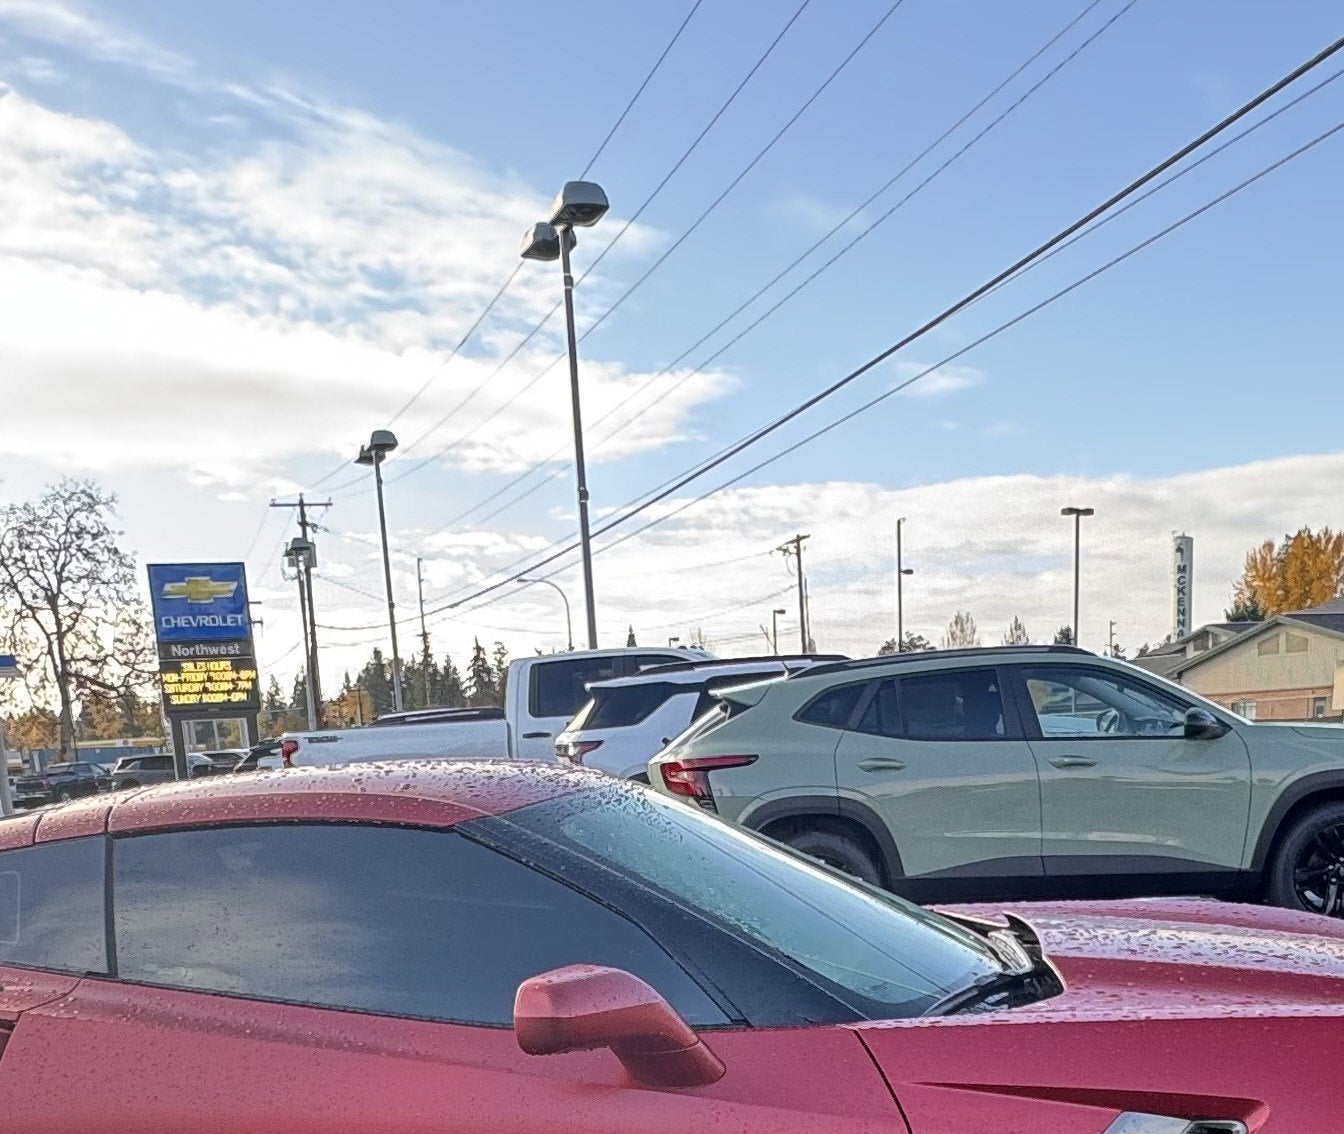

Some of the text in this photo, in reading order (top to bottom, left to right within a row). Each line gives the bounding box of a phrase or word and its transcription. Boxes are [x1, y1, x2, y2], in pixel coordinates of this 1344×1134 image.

[161, 614, 243, 629] CHEVROLET
[171, 643, 241, 657] Northwest
[181, 662, 206, 672] SALES
[164, 683, 204, 693] SATURDAY
[171, 693, 201, 704] SUNDAY
